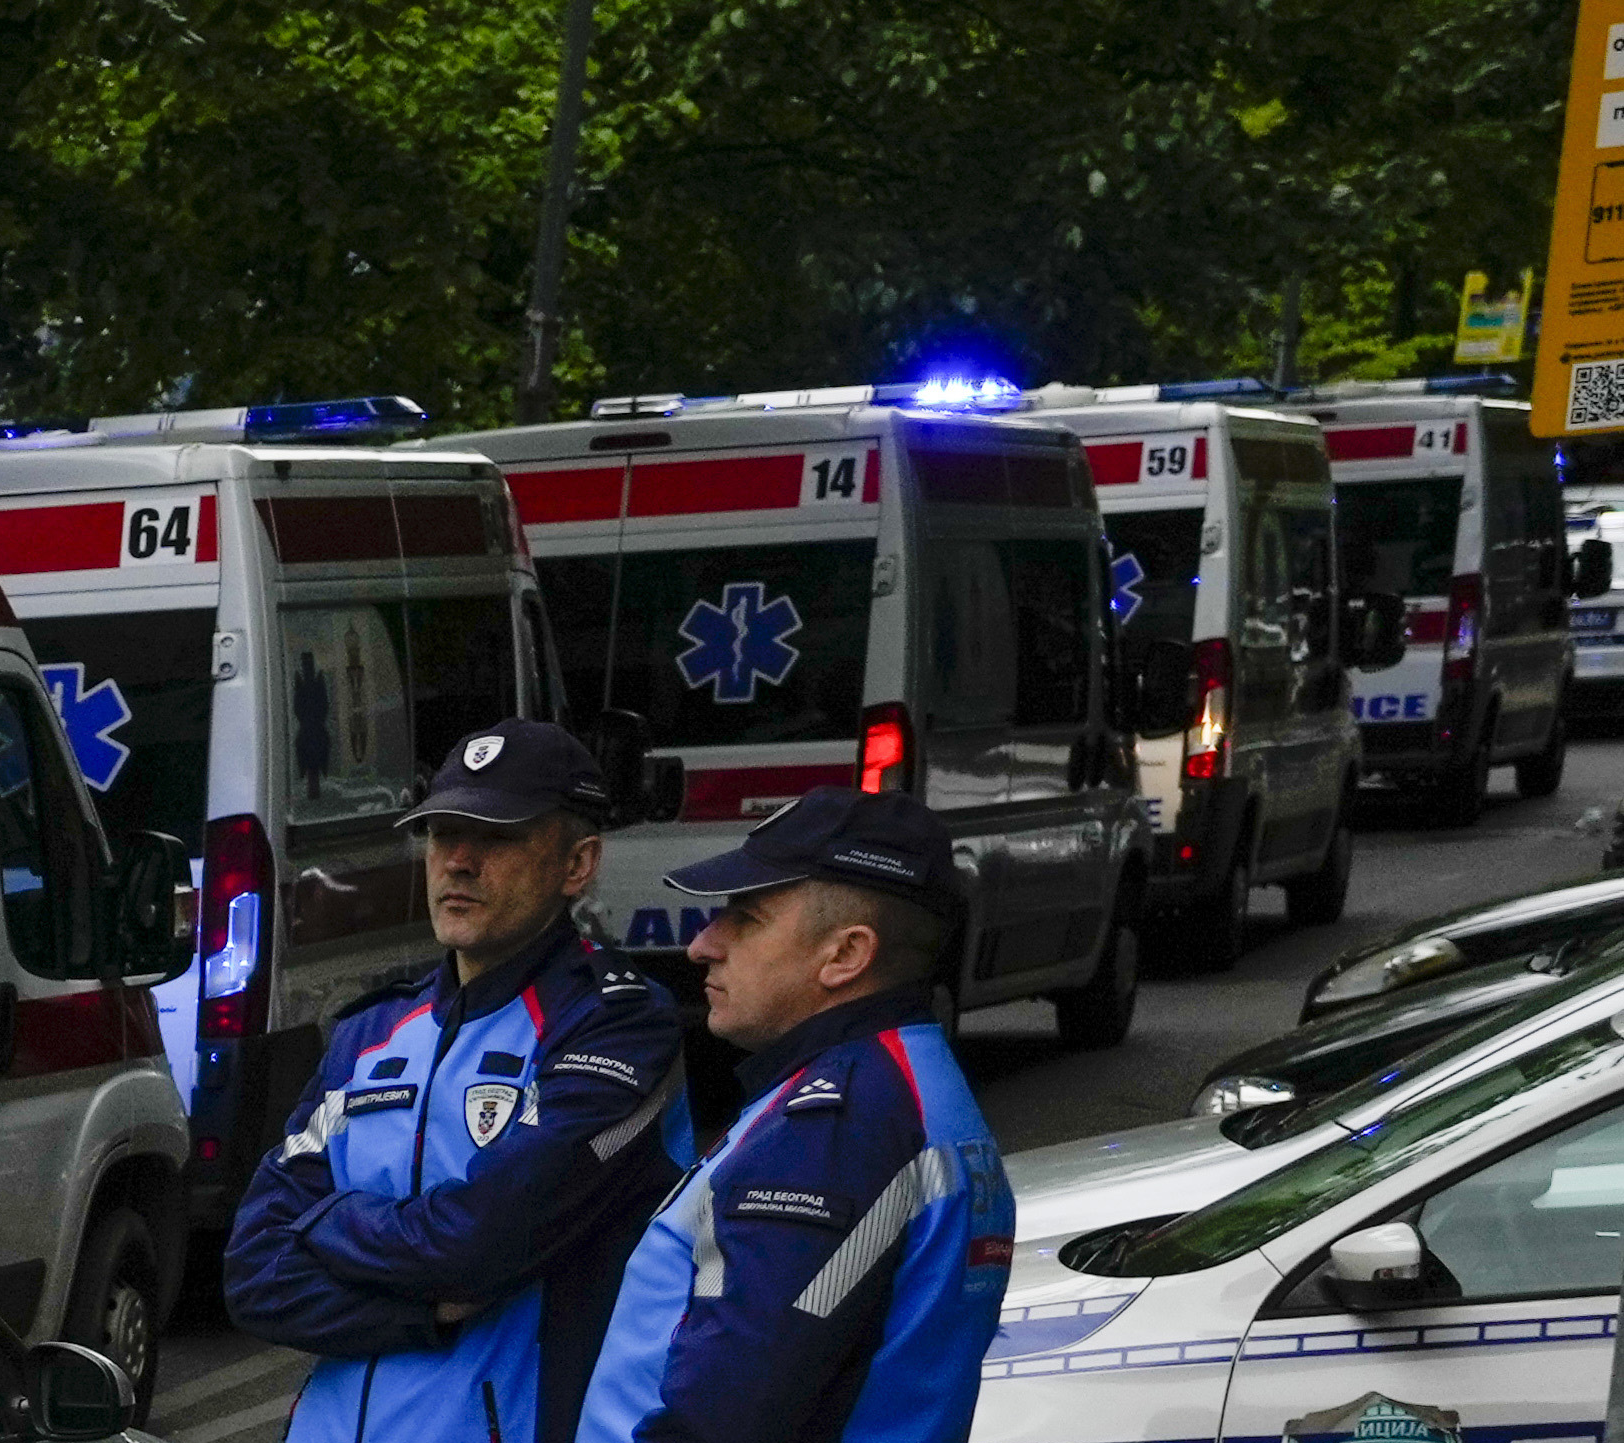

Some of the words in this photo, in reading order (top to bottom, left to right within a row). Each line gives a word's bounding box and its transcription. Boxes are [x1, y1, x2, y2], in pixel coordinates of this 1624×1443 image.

[1147, 446, 1187, 476] 59
[811, 457, 857, 500] 14
[128, 506, 191, 559] 64
[562, 1053, 588, 1064] ГРАД
[588, 1055, 635, 1076] БЕОГРАД
[746, 1190, 773, 1202] ГРАД
[773, 1191, 825, 1208] БЕОГРАД
